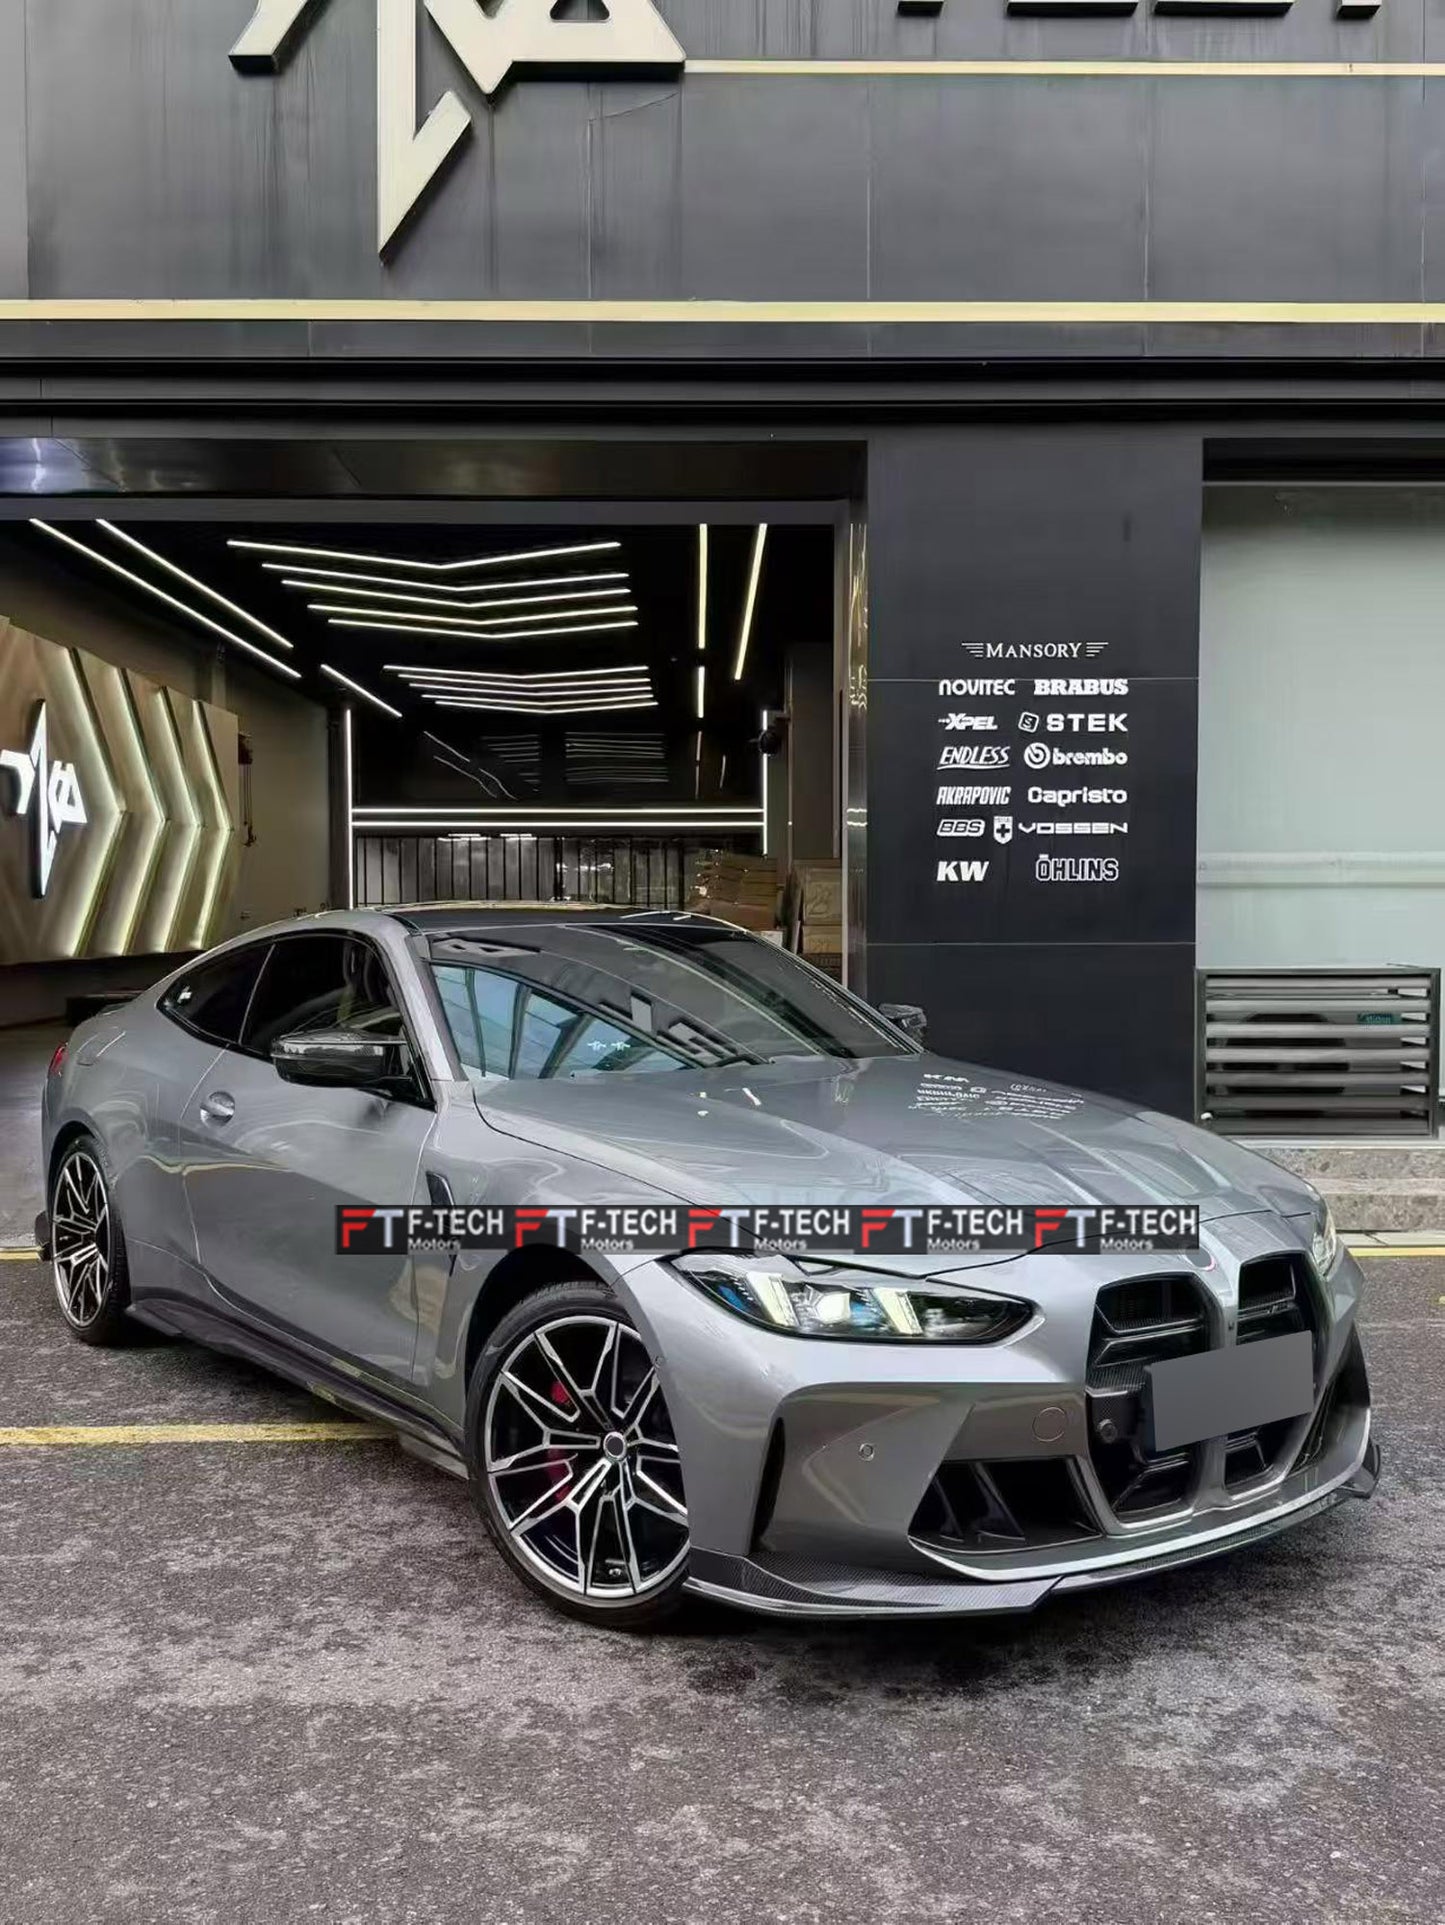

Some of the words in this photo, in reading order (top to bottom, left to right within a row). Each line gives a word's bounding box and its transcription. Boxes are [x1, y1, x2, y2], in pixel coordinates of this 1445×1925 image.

[986, 643, 1082, 658] MANSORY
[939, 679, 1015, 696] NOVITEC
[1033, 679, 1129, 696] BRABUS
[944, 713, 998, 730] XPEL
[1046, 713, 1128, 732] STEK
[939, 746, 1011, 765] ENDLESS
[1052, 748, 1128, 765] brembo
[1027, 786, 1128, 807] Capristo
[937, 819, 985, 837] BBS
[1018, 822, 1128, 835] VOSSEN
[937, 861, 989, 882] KW
